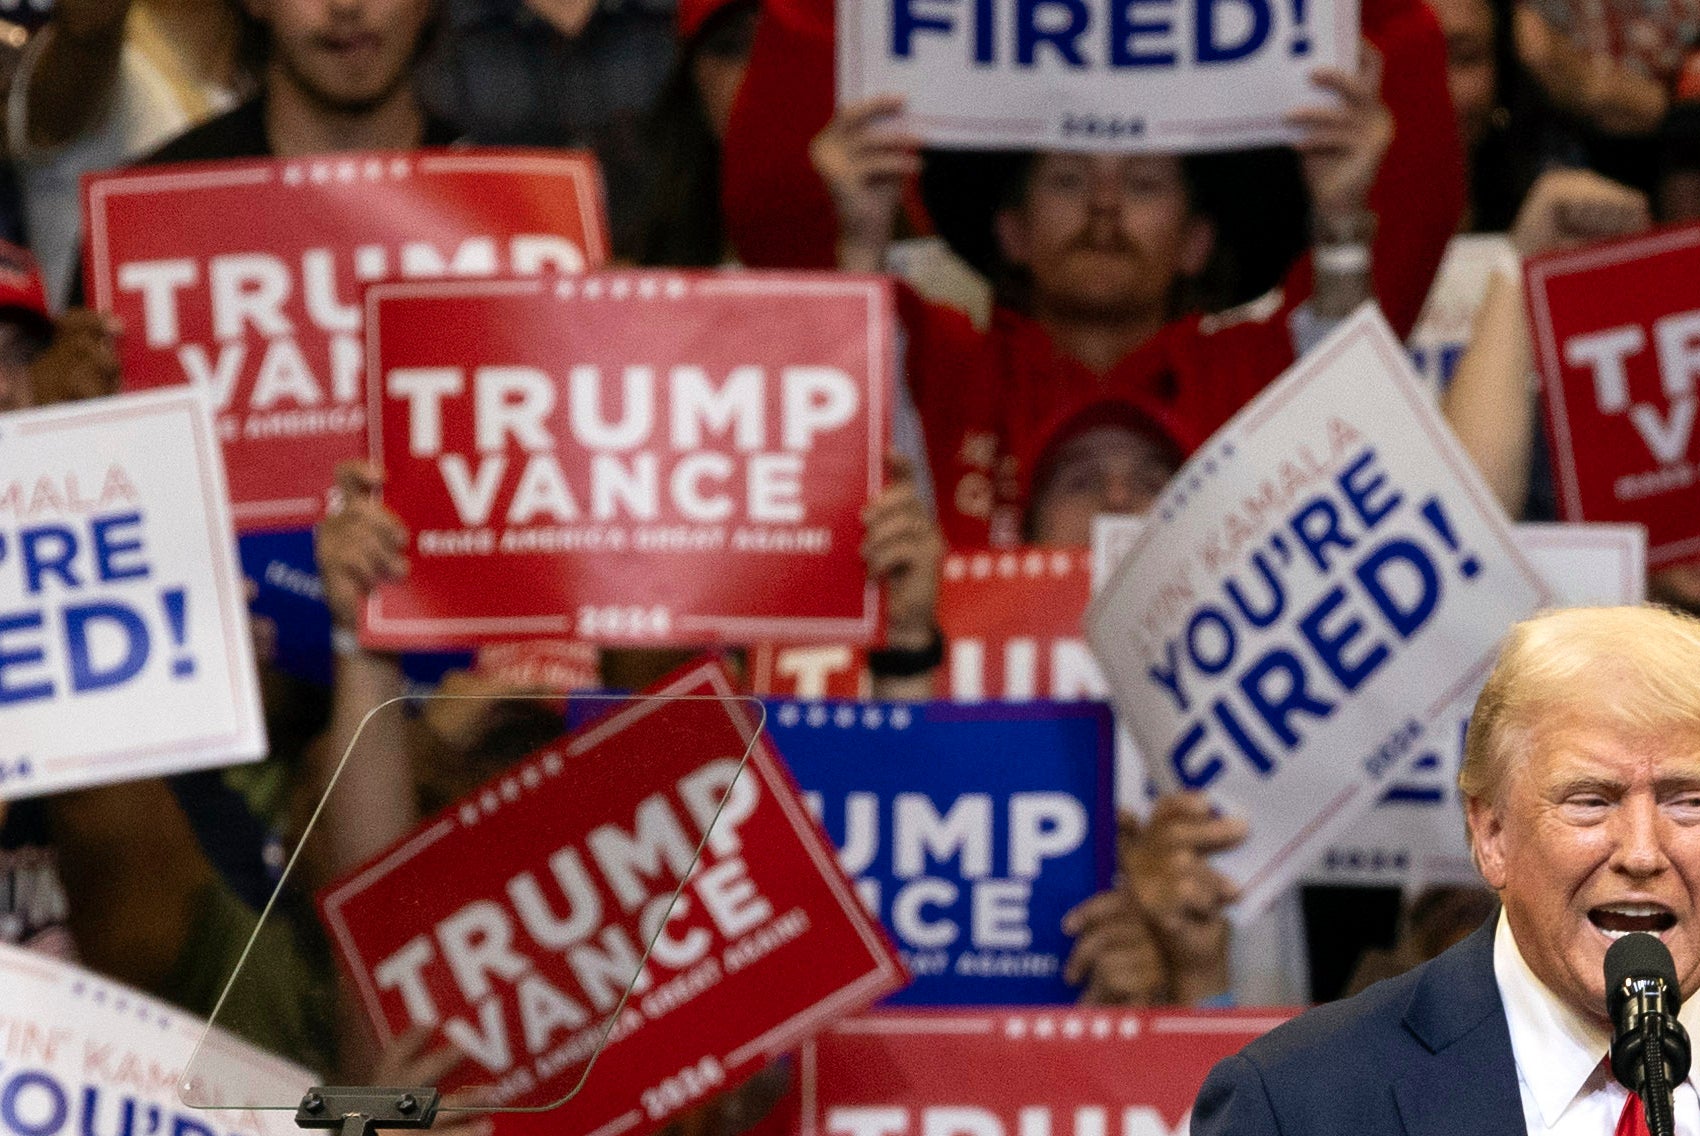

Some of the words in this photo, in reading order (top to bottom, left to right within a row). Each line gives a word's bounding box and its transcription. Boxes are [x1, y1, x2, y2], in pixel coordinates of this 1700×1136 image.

[888, 0, 1314, 69] FIRED!
[387, 364, 860, 457] TRUMP
[437, 450, 807, 526] VANCE
[1149, 447, 1407, 712] YOU'RE
[1168, 494, 1484, 792] FIRED!
[373, 756, 762, 1031] TRUMP
[802, 789, 1091, 881] UMP
[441, 853, 775, 1074] VANCE
